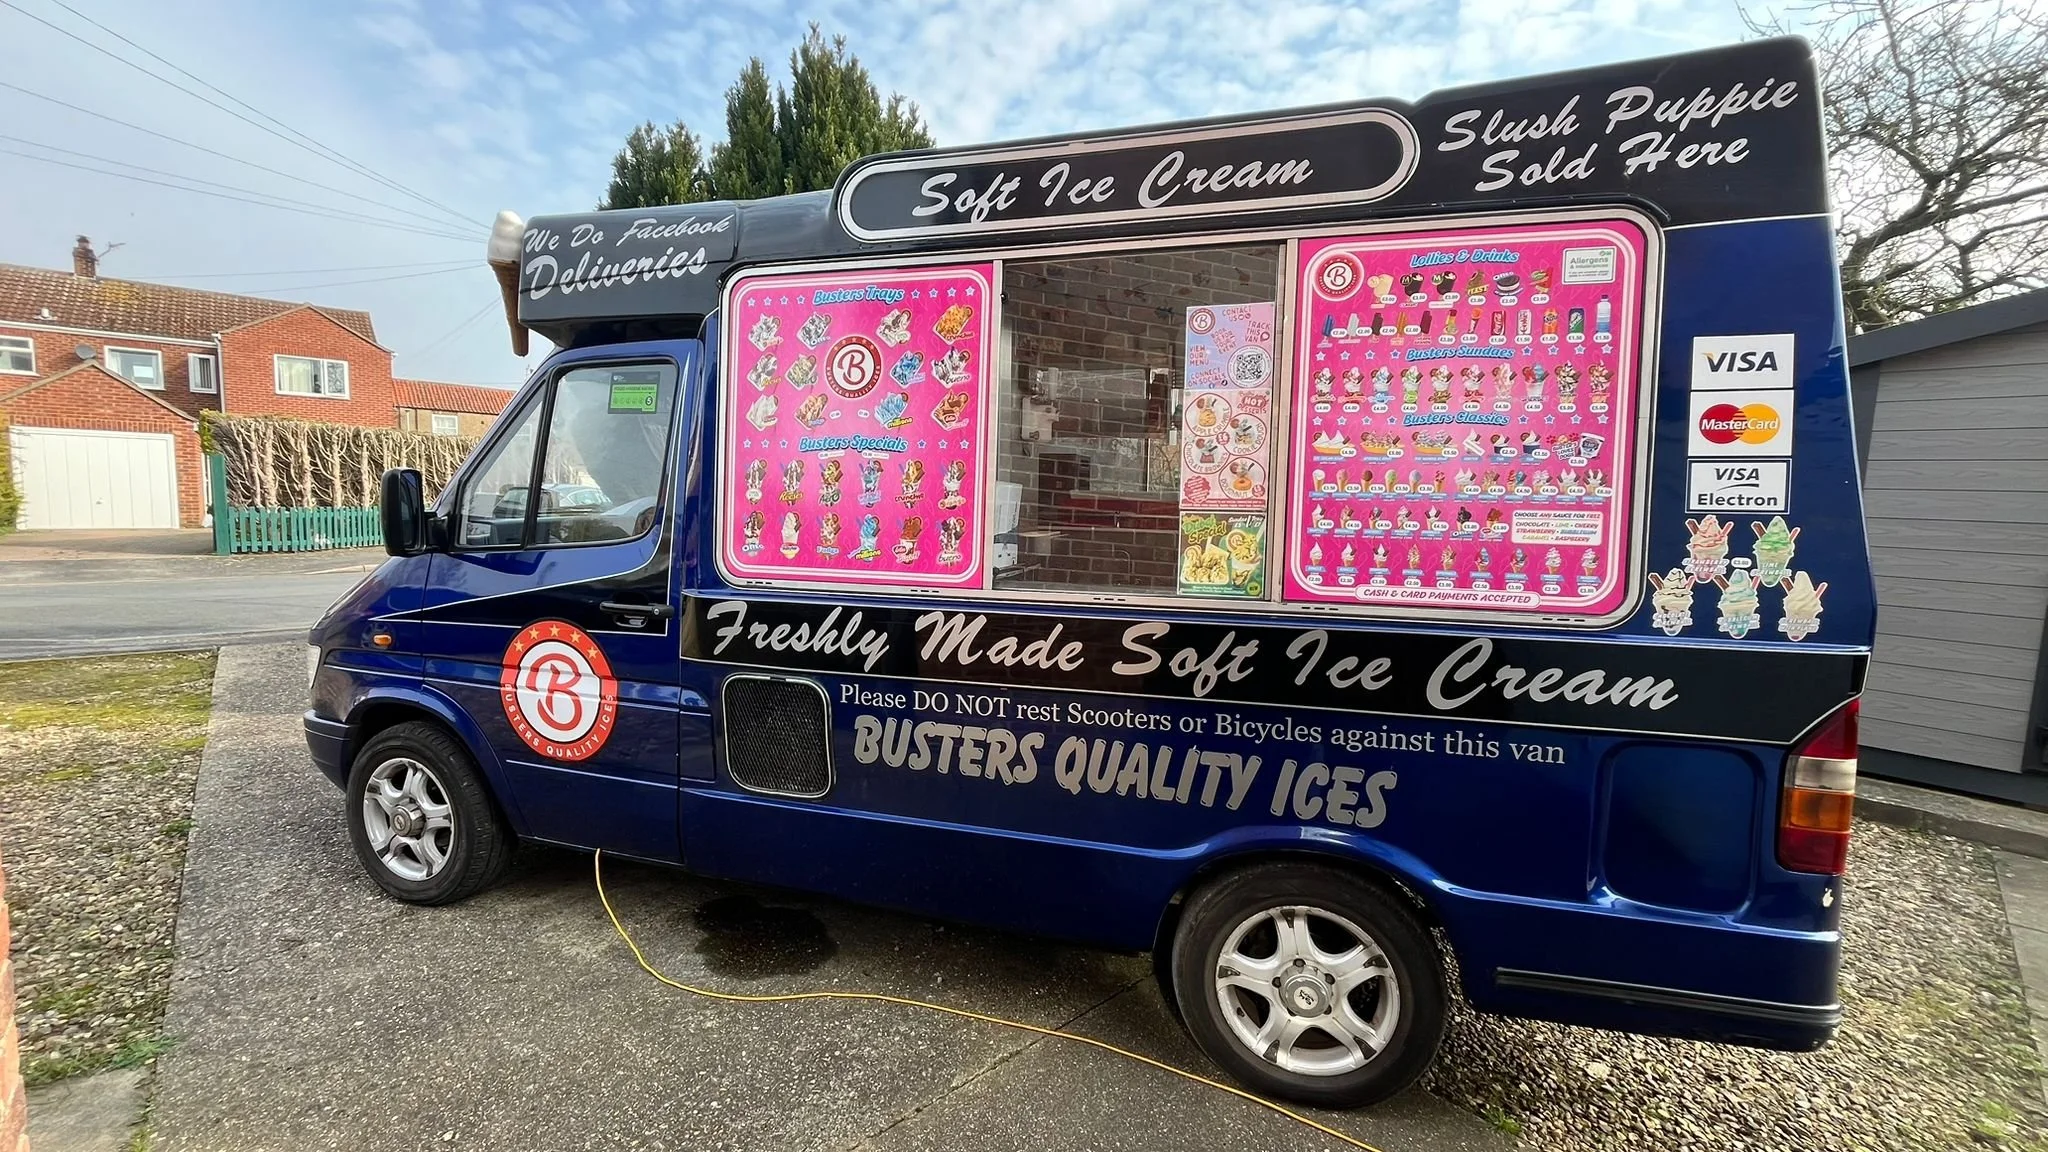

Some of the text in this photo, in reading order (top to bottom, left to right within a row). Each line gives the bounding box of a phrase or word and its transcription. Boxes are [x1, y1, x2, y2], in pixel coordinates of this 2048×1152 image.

[1437, 77, 1799, 152] Slush Puppie
[1474, 131, 1750, 193] Sold Here
[912, 149, 1314, 225] Soft Ice Cream
[524, 214, 736, 253] We Do Facebook
[1410, 251, 1453, 267] Lollies
[1471, 248, 1520, 263] Drinks
[526, 247, 708, 301] Deliveries
[814, 285, 904, 305] Busters Trays
[1222, 306, 1252, 317] CONTACT
[1248, 321, 1270, 330] TRACK
[1406, 344, 1515, 361] Busters Sundaes
[1702, 351, 1778, 373] VISA
[837, 350, 866, 386] B
[1191, 368, 1220, 379] CONNECT
[1199, 373, 1226, 384] SOCIALS
[1244, 397, 1262, 406] HOT
[1403, 411, 1510, 426] Busters Classics
[1701, 418, 1779, 431] MasterCard
[799, 434, 908, 452] Busters Specials
[1715, 468, 1760, 481] VISA
[1698, 493, 1778, 506] Electron
[1189, 521, 1227, 543] Special
[1363, 588, 1532, 604] CASH & CARD PAYMENTS ACCEPTED
[706, 601, 1679, 710] Freshly Made Soft Ice Cream
[525, 652, 583, 731] B
[546, 734, 601, 758] QUALITY
[600, 694, 614, 731] ICES
[839, 683, 1566, 765] Please DO NOT rest Scooters or Bicycles against this van
[853, 714, 1398, 829] BUSTERS QUALITY ICES
